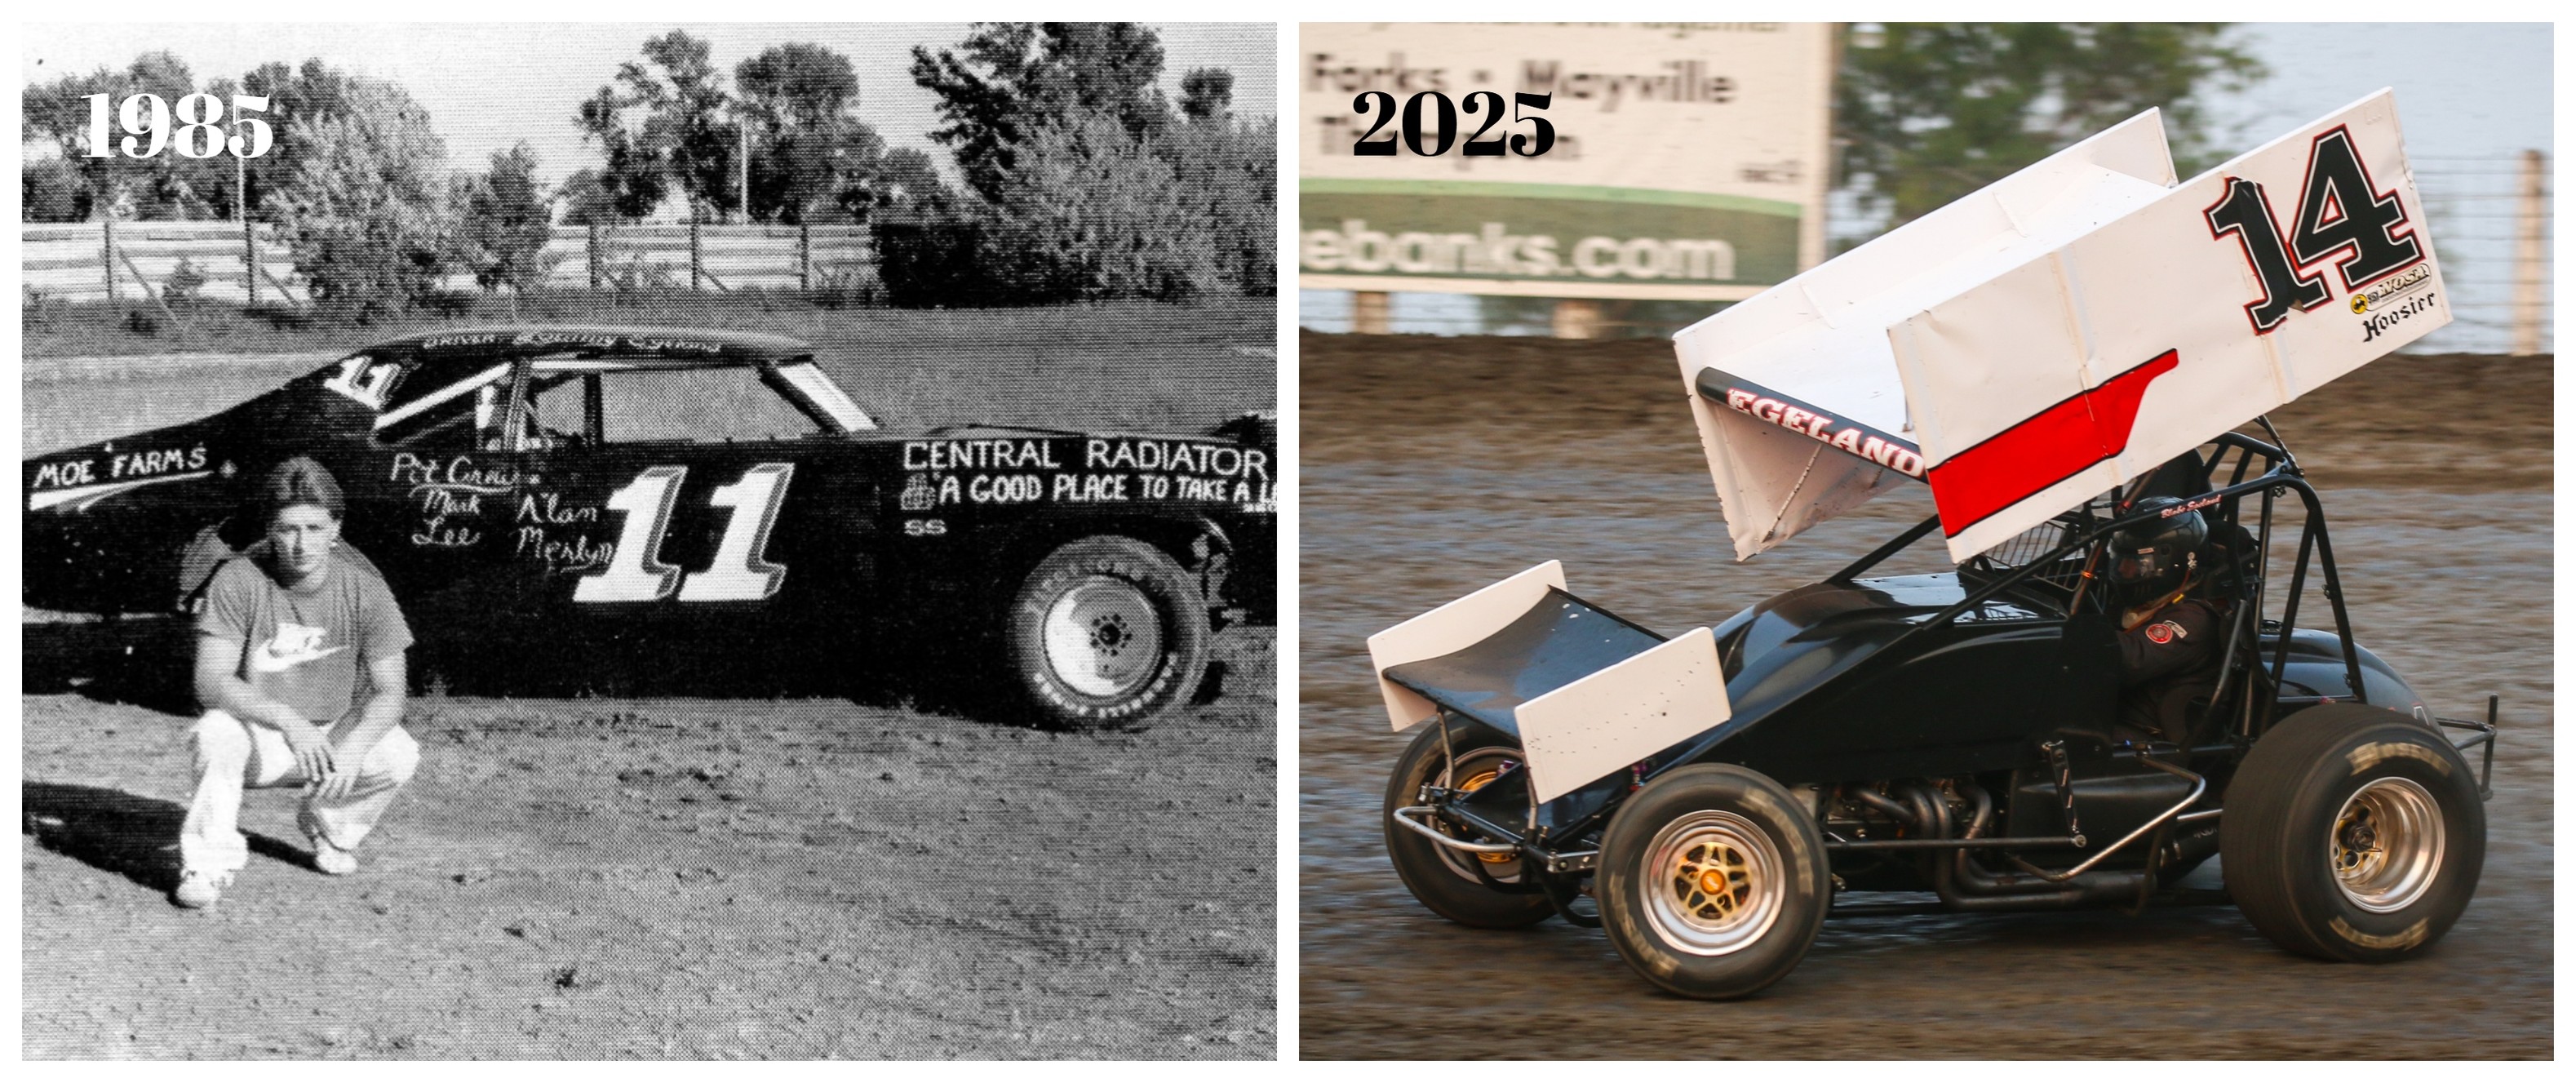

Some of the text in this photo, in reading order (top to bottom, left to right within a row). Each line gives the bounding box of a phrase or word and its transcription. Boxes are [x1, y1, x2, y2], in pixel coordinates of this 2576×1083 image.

[1299, 219, 1736, 280] ebanks.com
[2201, 122, 2427, 336] 14
[2362, 292, 2435, 343] Hoosier
[322, 355, 402, 411] 11
[902, 439, 1269, 480] CENTRAL RADIATOR
[1726, 387, 1926, 479] EGELAND
[32, 447, 207, 488] MOE FARMS
[969, 473, 1043, 504] GOOD
[1053, 473, 1129, 503] PLACE
[1138, 473, 1169, 499] TO
[1175, 475, 1227, 502] TAKE
[1233, 480, 1250, 504] A
[410, 515, 481, 547] Lee
[572, 463, 796, 602] 11
